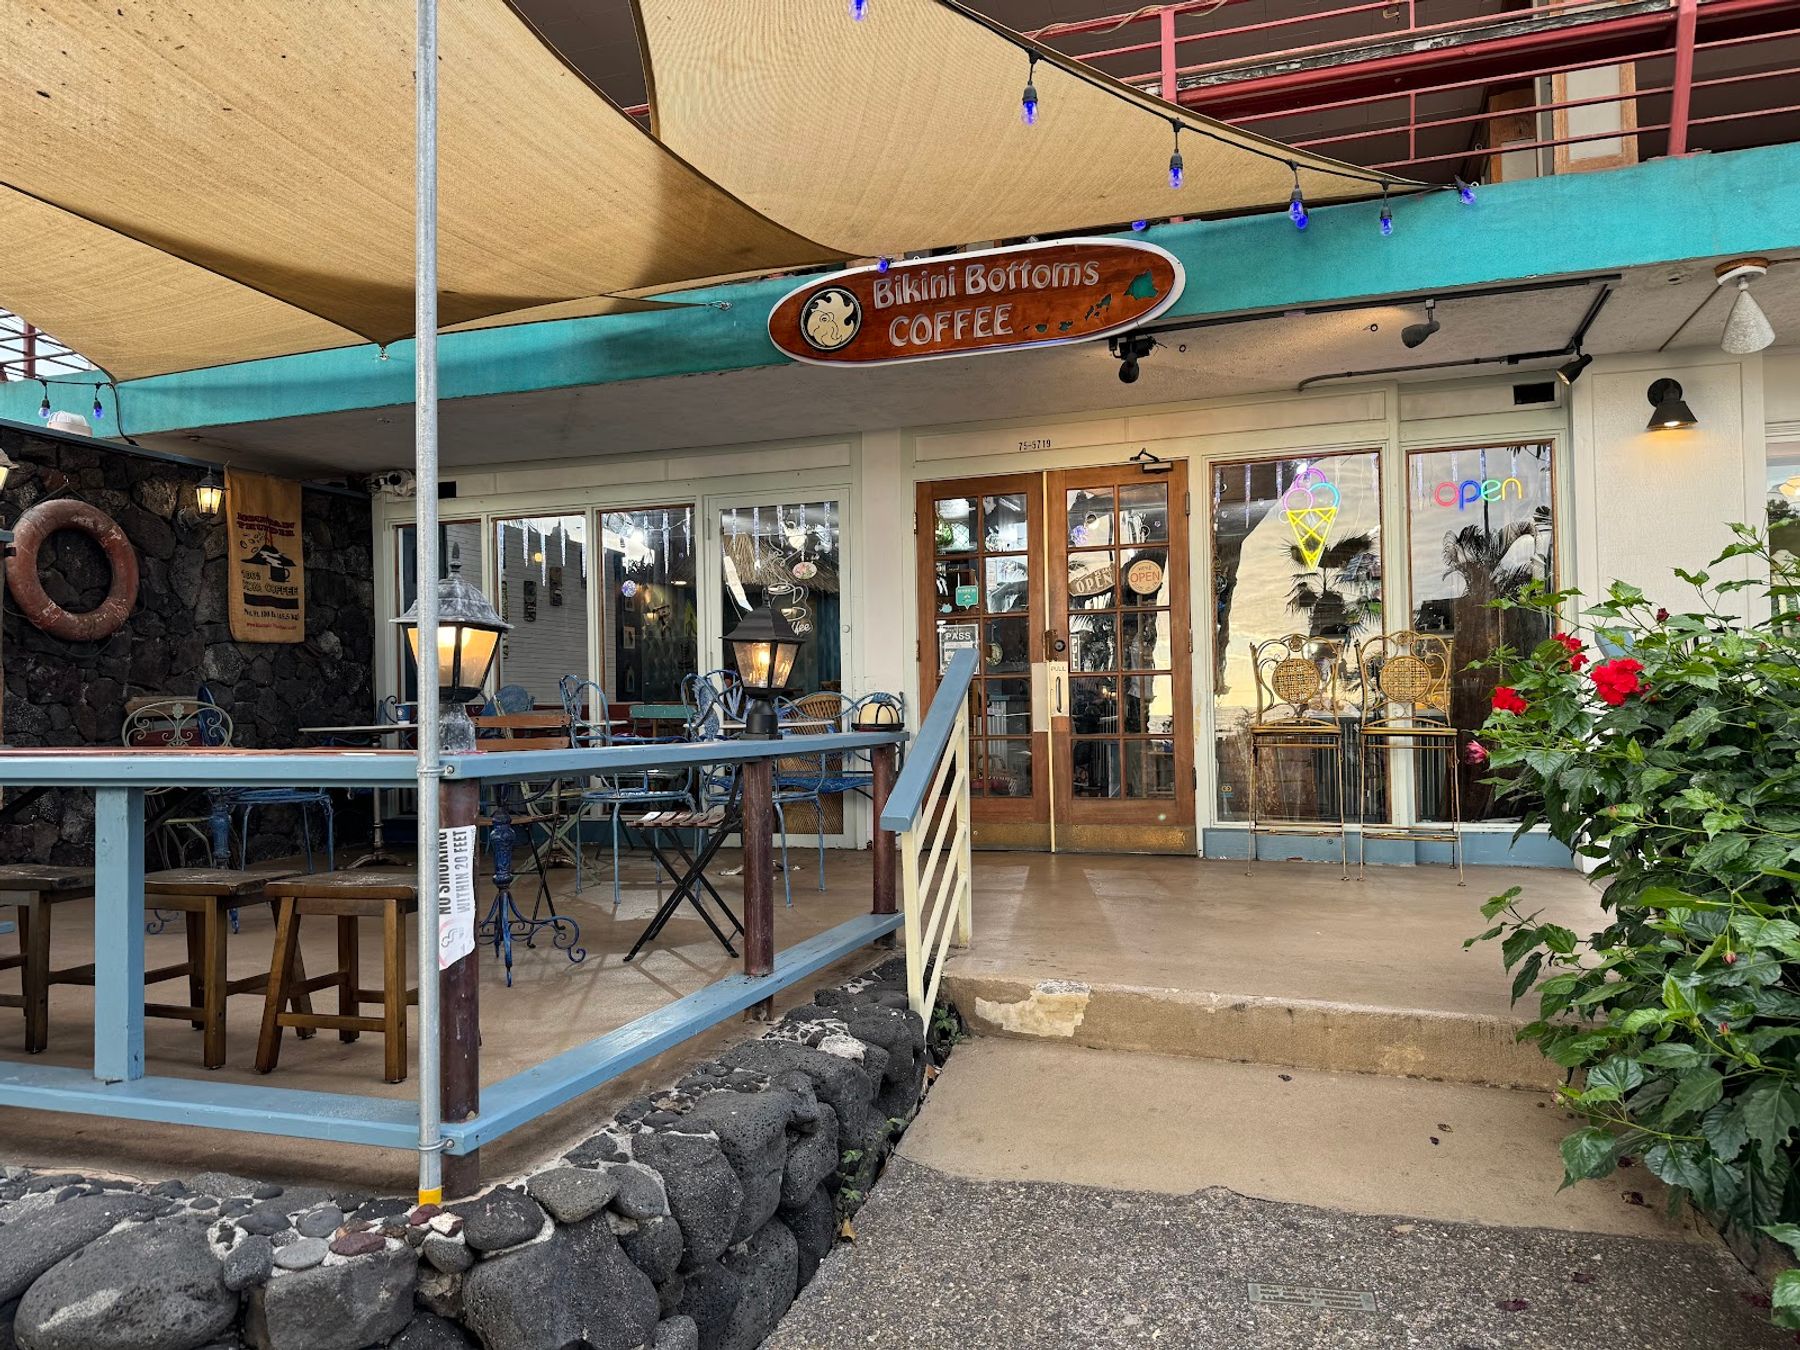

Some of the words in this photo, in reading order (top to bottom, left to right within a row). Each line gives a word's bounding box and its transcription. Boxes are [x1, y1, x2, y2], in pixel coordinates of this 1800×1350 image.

[873, 266, 956, 310] Bikini
[965, 261, 1100, 295] Bottoms
[888, 303, 1014, 347] COFFEE
[1018, 438, 1051, 451] 75-5719
[1434, 477, 1523, 512] open
[1076, 570, 1113, 593] OPEN
[1130, 571, 1160, 583] OPEN
[264, 582, 299, 596] COFFEE
[945, 632, 972, 641] PASS
[452, 831, 468, 853] FEET
[454, 856, 469, 871] 20
[455, 872, 471, 914] WITHIN
[438, 897, 452, 915] NO
